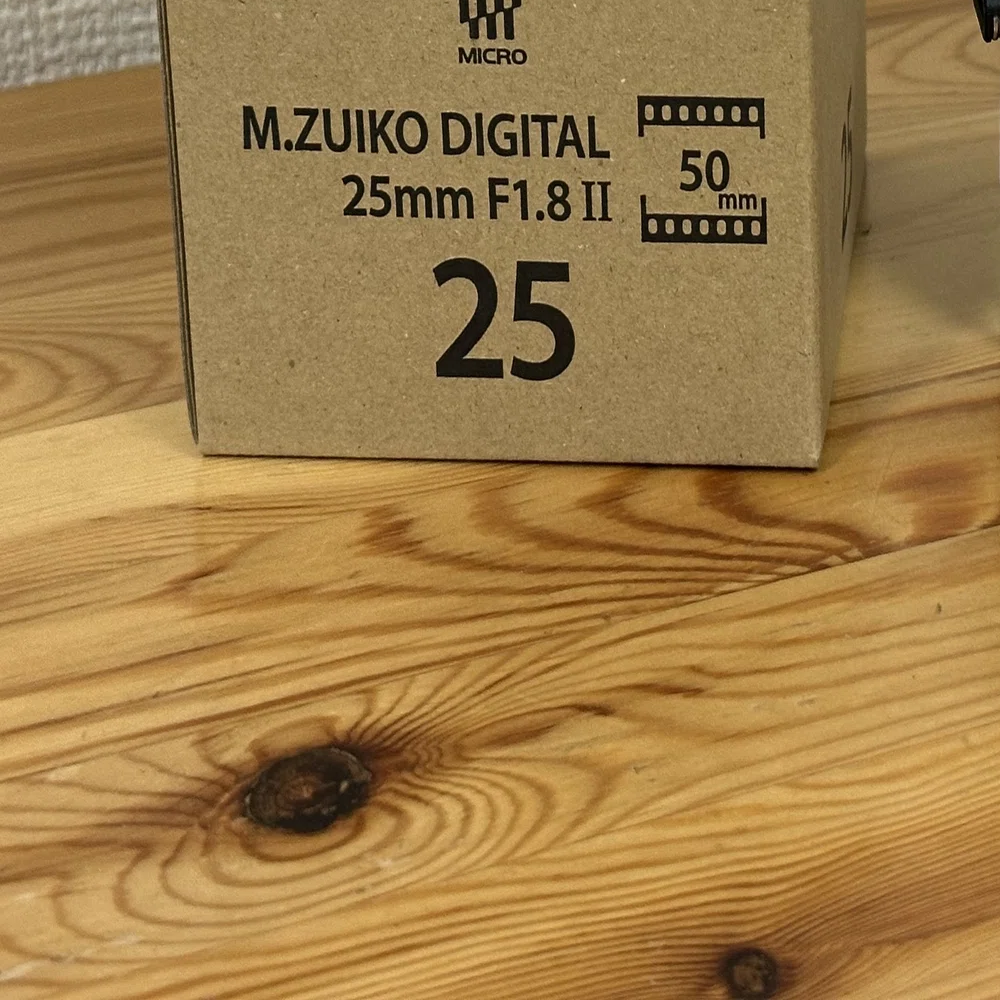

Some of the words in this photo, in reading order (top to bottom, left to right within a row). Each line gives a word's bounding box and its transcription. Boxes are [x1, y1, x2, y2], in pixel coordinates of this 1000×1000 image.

[457, 46, 528, 66] MICRO
[242, 105, 429, 155] M.ZUIKO
[440, 111, 611, 159] DIGITAL
[679, 149, 730, 192] 50
[341, 174, 475, 220] 25mm
[487, 176, 572, 222] F1.8
[718, 193, 758, 211] mm
[432, 257, 576, 382] 25
